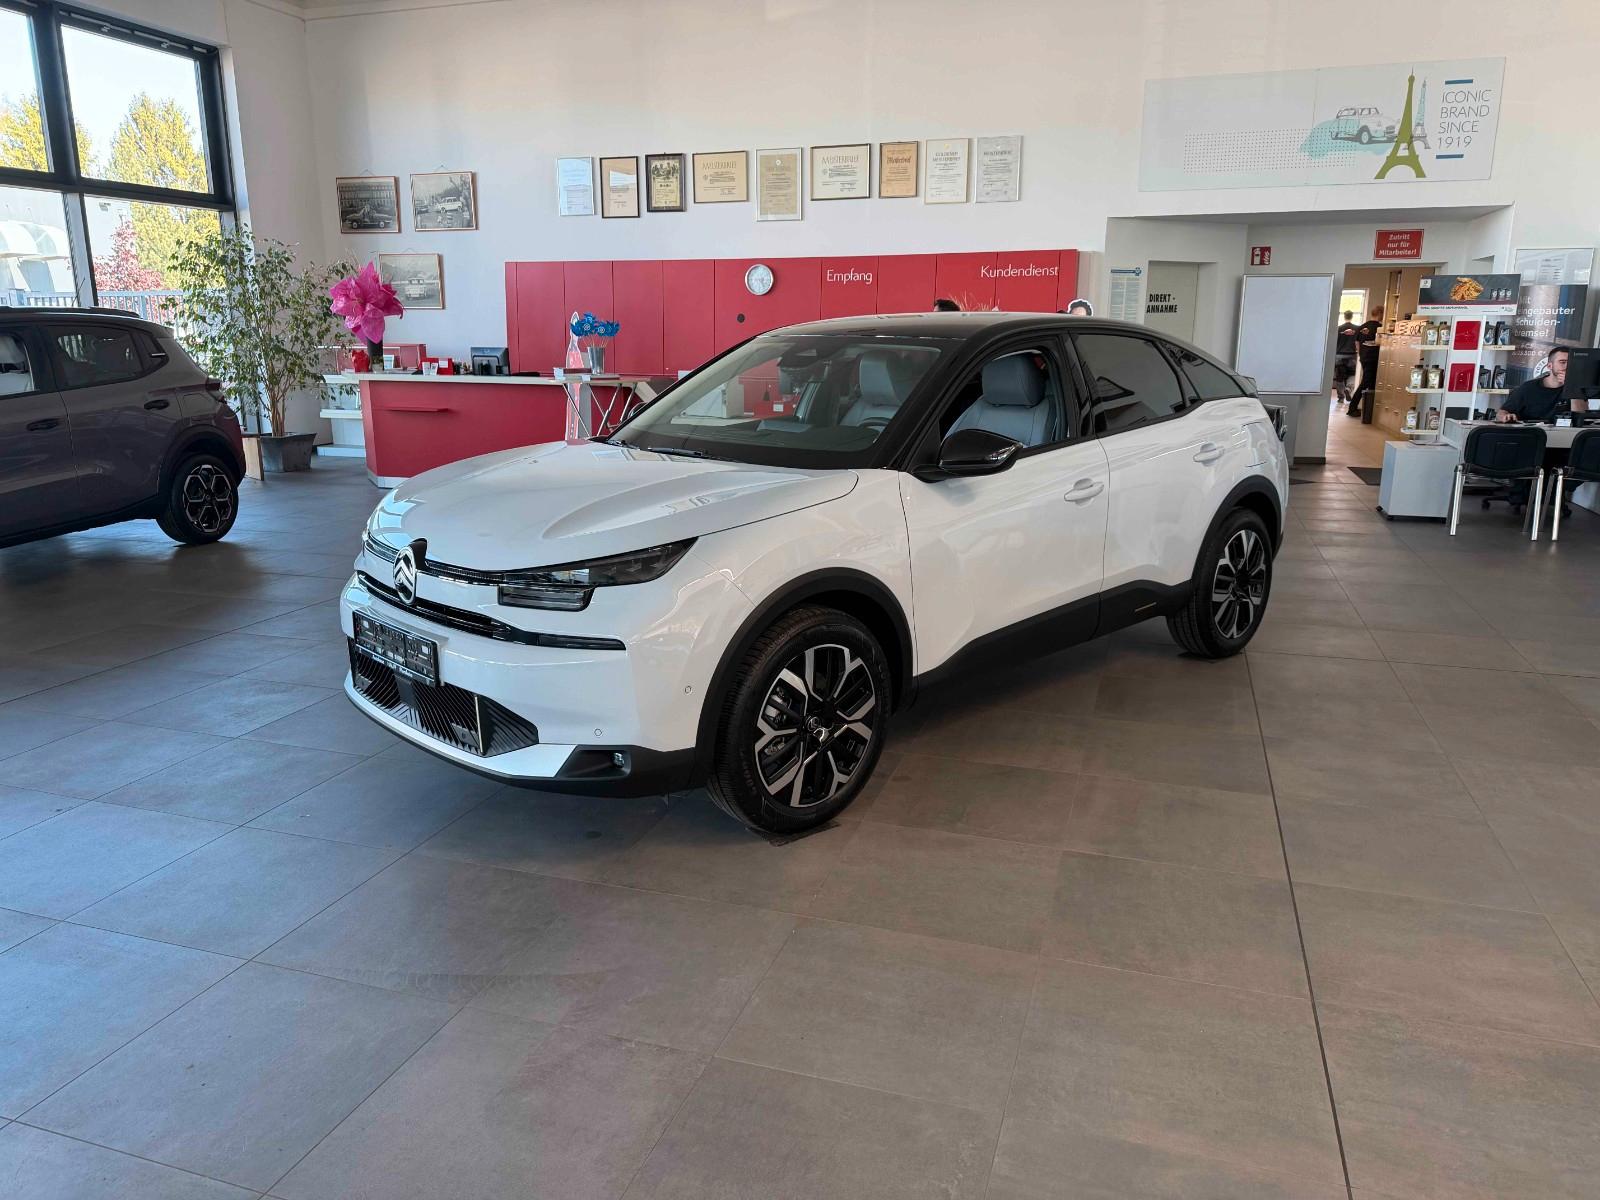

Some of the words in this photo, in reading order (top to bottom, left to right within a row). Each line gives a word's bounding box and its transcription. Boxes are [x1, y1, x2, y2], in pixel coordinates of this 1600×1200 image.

[1442, 89, 1491, 103] ICONIC
[1440, 104, 1489, 118] BRAND
[1438, 120, 1479, 134] SINCE
[1438, 135, 1473, 149] 1919
[1389, 233, 1410, 241] Zutritt
[1400, 240, 1410, 248] für
[1378, 248, 1417, 256] Mitarbeiter!
[826, 267, 873, 285] Empfang
[981, 263, 1058, 278] Kundendienst
[1149, 293, 1171, 303] DIREKT
[1146, 304, 1178, 313] ANNAHME
[1515, 317, 1560, 327] Schulden-
